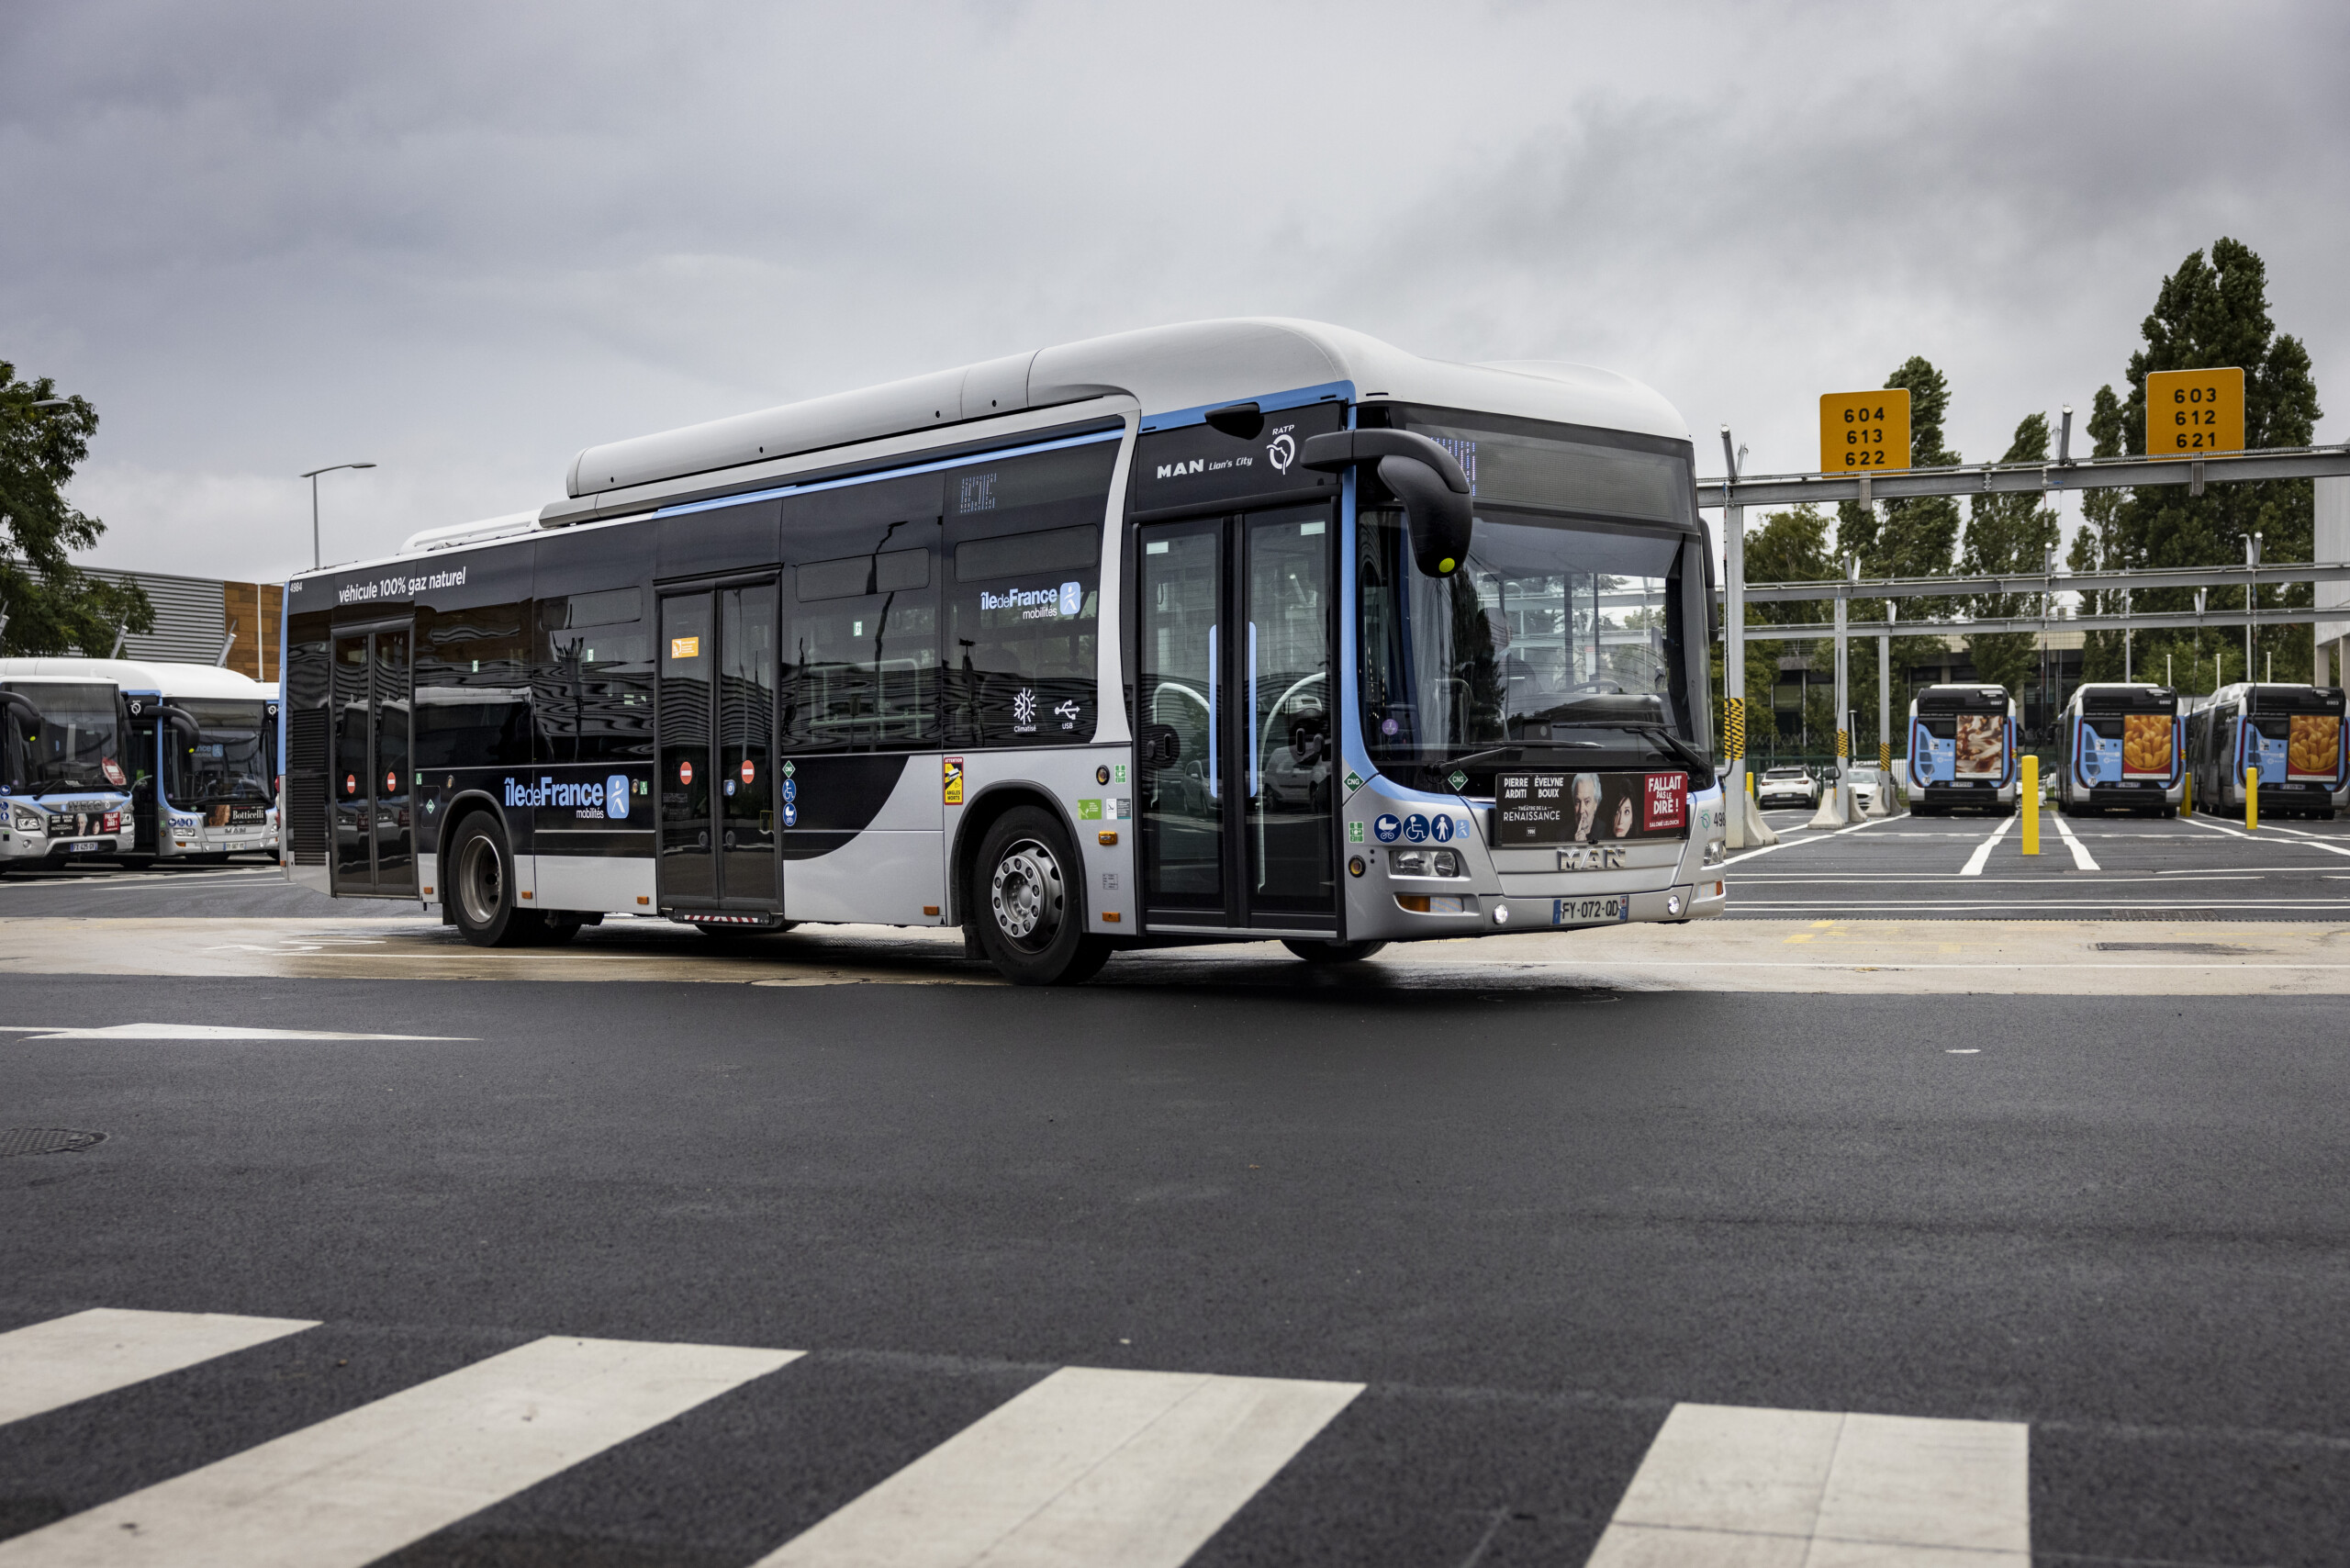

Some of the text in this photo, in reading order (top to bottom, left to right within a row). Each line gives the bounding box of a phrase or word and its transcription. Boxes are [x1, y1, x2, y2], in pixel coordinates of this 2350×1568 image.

[2175, 387, 2216, 403] 603
[1844, 407, 1885, 423] 604
[2176, 409, 2216, 425] 612
[1272, 424, 1294, 435] RATP
[1847, 429, 1883, 444] 613
[2177, 431, 2215, 448] 621
[1845, 450, 1885, 466] 622
[1157, 457, 1253, 479] MAN Lion's City
[339, 566, 466, 603] véhicule 100% gaz naturel
[1023, 605, 1058, 620] mobilités
[1013, 724, 1036, 733] Climatisé
[1061, 722, 1073, 730] USB
[1504, 775, 1563, 787] PIERRE ÉVELYNE
[1648, 775, 1682, 792] FALLAIT
[1505, 789, 1559, 799] ARDITI BOUIX
[232, 810, 263, 820] Botticelli
[576, 807, 604, 819] mobilités
[1653, 799, 1673, 815] DIRE
[1503, 811, 1561, 821] RENAISSANCE
[1557, 846, 1626, 870] MAN
[1562, 900, 1618, 919] FY-072-QD
